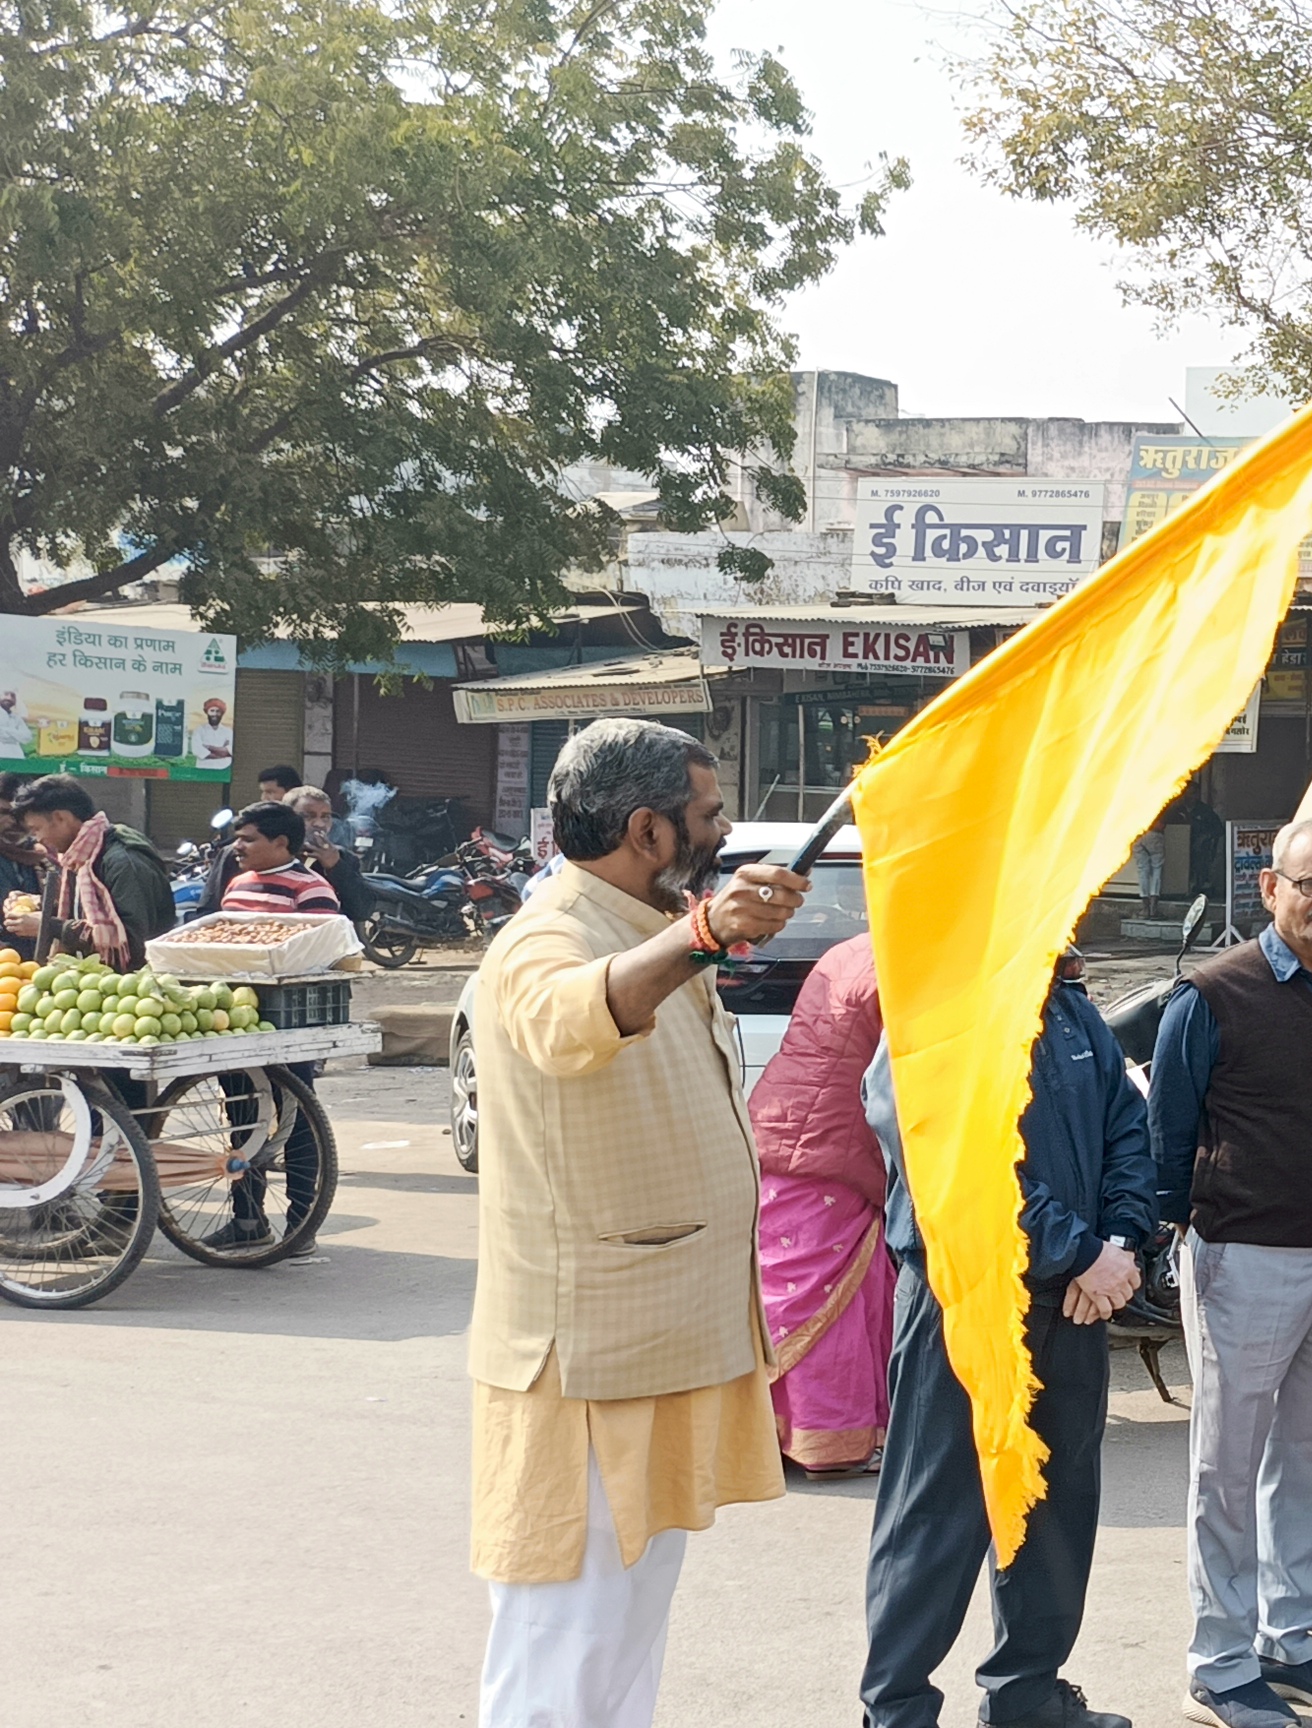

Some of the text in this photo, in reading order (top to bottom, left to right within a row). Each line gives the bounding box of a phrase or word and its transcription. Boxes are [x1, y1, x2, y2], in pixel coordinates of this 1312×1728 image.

[870, 489, 940, 498] M. 7597926620
[1017, 489, 1090, 499] M. 9772865476
[869, 504, 1087, 568] ई किसान
[954, 576, 986, 592] बीज
[993, 577, 1013, 594] एवं
[55, 626, 176, 653] इंडिया का प्रणाम
[46, 650, 183, 676] हर किसान के नाम
[496, 697, 530, 713] S.P.C.
[533, 693, 607, 710] ASSOCIATES
[610, 694, 620, 707] &
[623, 688, 704, 707] DEVELOPERS
